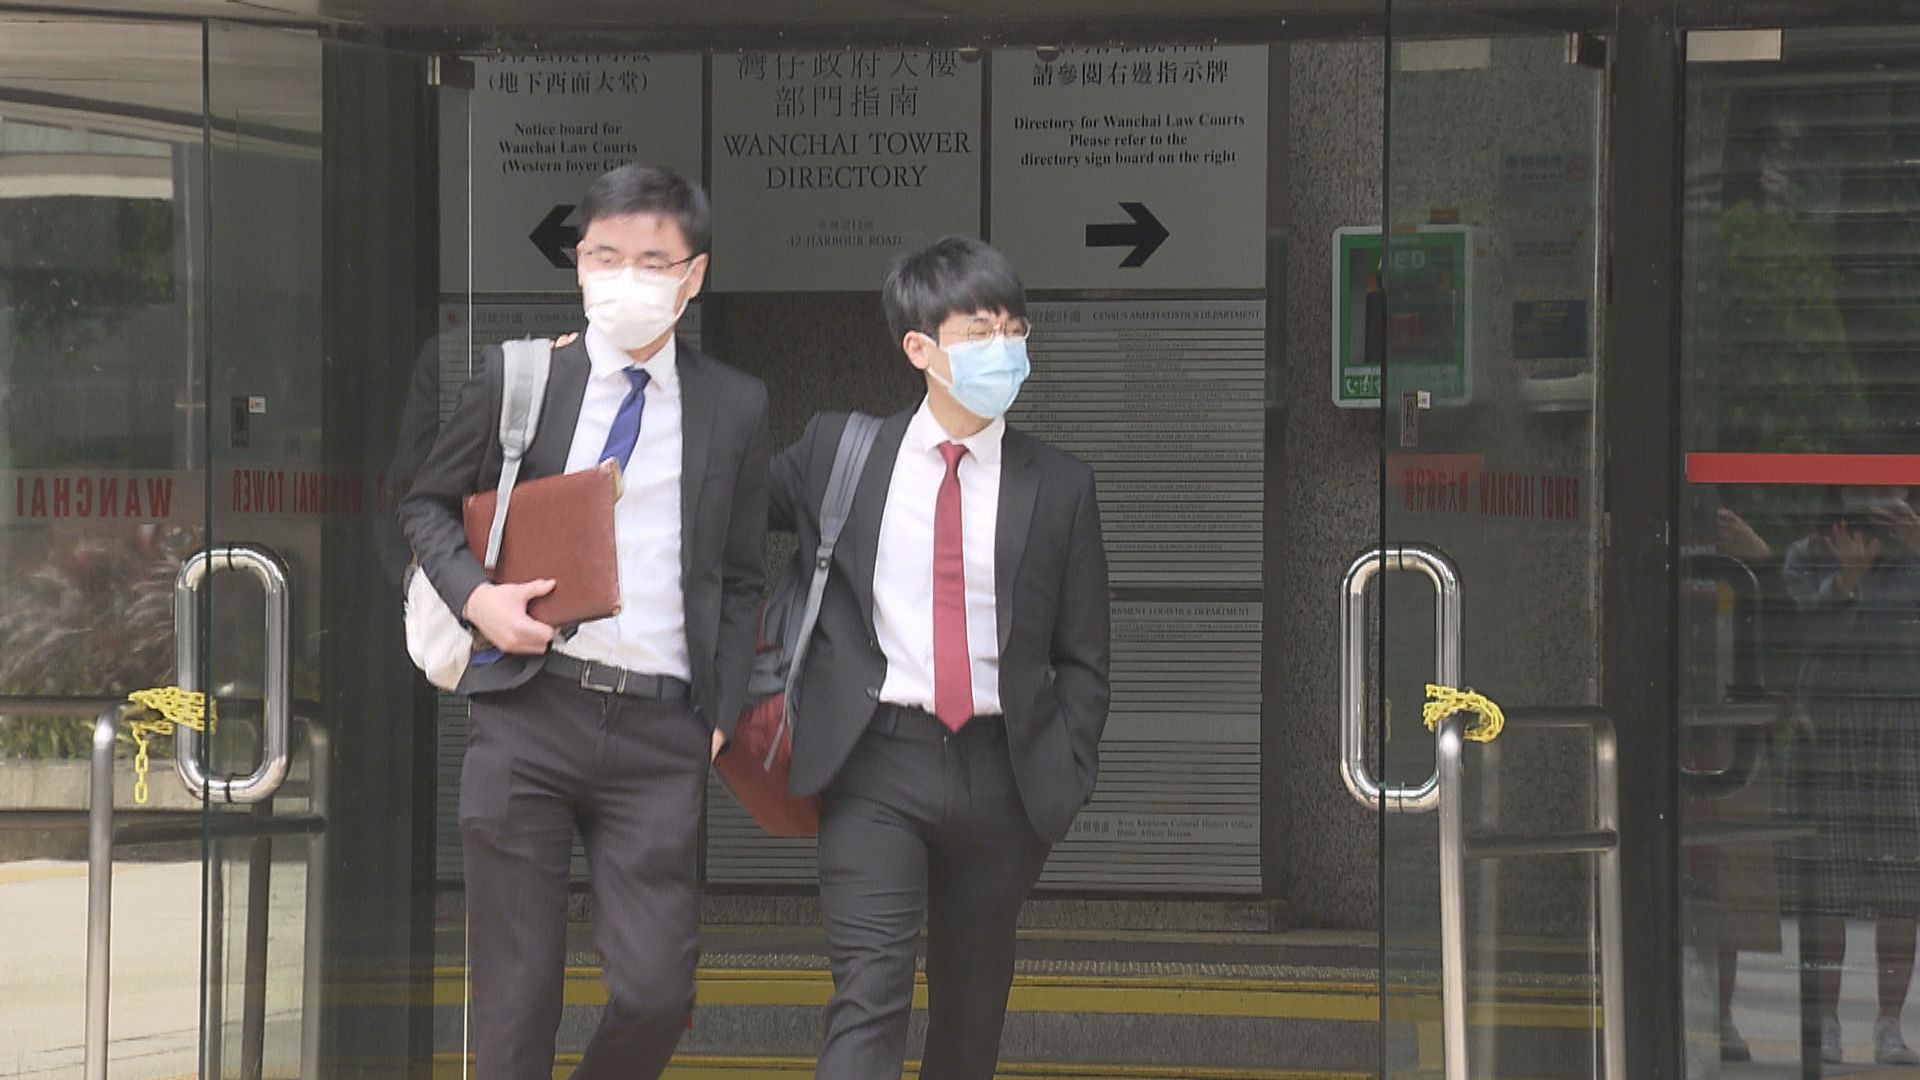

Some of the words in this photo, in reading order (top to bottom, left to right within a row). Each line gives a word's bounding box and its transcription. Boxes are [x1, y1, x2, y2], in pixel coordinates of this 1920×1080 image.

[737, 50, 959, 81] 灣仔政府大樓
[775, 84, 919, 118] 部門指南
[514, 121, 556, 136] Notice
[560, 120, 599, 136] board
[603, 120, 622, 135] for
[1014, 116, 1075, 131] Directory
[1081, 115, 1100, 129] for
[1103, 114, 1162, 128] Wanchai
[1166, 114, 1195, 127] Law
[1199, 113, 1246, 127] Courts
[499, 140, 556, 155] Wanchai
[560, 140, 588, 154] Law
[592, 140, 638, 154] Courts
[723, 132, 859, 158] WANCHAI
[867, 131, 972, 155] TOWER
[1070, 133, 1110, 147] Please
[1114, 132, 1145, 146] refer
[1150, 134, 1162, 146] to
[1167, 132, 1188, 146] the
[502, 158, 561, 174] (Western
[566, 158, 601, 175] foyer
[1021, 152, 1080, 168] directory
[1085, 152, 1111, 167] sign
[1115, 150, 1154, 164] board
[1158, 153, 1175, 164] on
[1179, 150, 1200, 163] the
[1204, 149, 1236, 165] right
[766, 164, 928, 190] DIRECTORY
[806, 235, 864, 248] HARBOUR
[868, 234, 903, 248] ROAD
[1479, 471, 1535, 520] WANCHAI
[1540, 475, 1580, 521] TOWER
